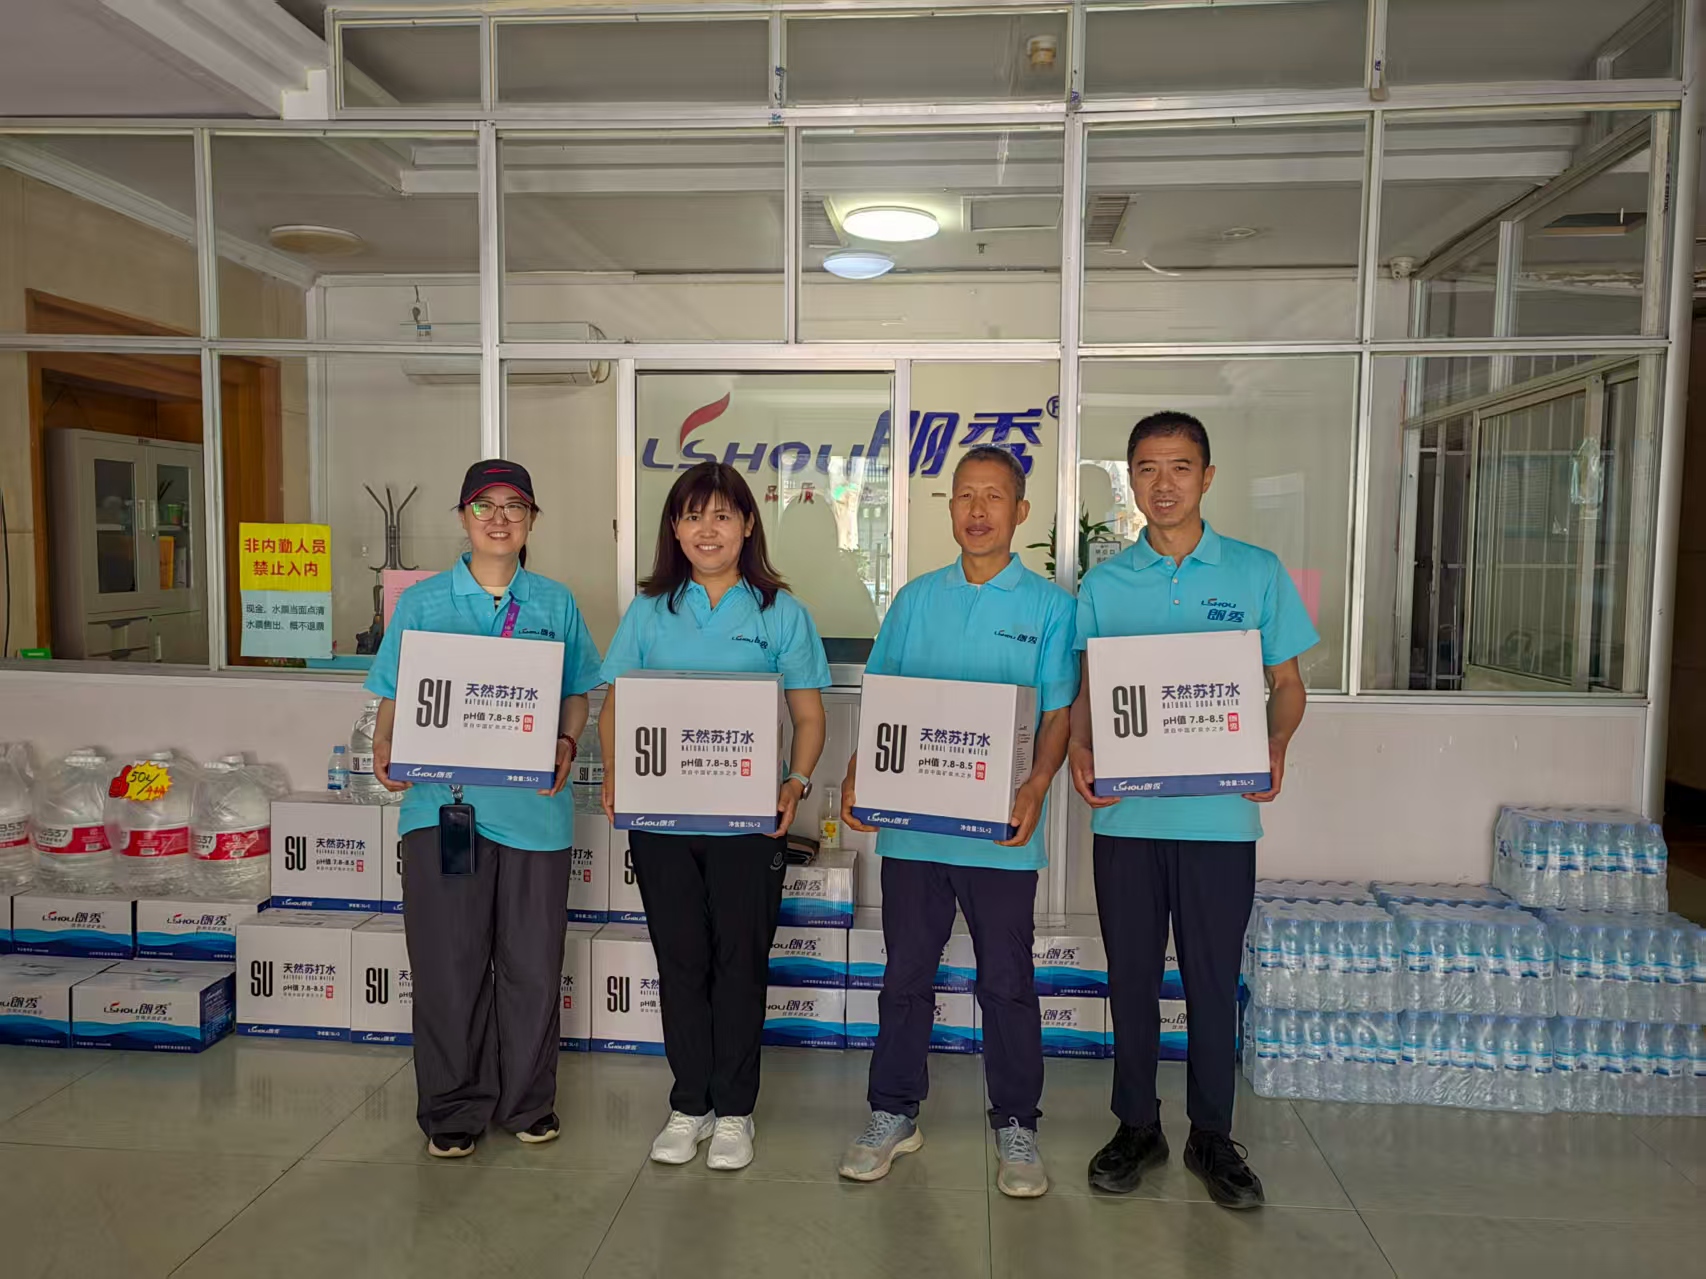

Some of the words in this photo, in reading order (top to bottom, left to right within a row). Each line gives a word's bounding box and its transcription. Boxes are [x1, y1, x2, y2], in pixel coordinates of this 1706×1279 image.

[244, 538, 327, 554] 非内勤人员
[253, 560, 319, 577] 禁止入内
[1207, 609, 1245, 623] 朗秀
[465, 683, 538, 701] 天然苏打水
[1161, 682, 1240, 700] 天然苏打水
[416, 678, 452, 728] SU
[1112, 684, 1148, 738] SU
[488, 713, 520, 723] 7.8-8.5
[1189, 714, 1224, 725] 7.8-8.5
[681, 729, 755, 744] 天然苏打水
[919, 728, 991, 748] 天然苏打水
[635, 727, 667, 777] SU
[875, 723, 907, 774] SU
[706, 759, 738, 768] 7.8-8.5
[942, 759, 973, 770] 7.8-8.5
[316, 838, 366, 850] 天然苏打水
[285, 836, 307, 871] SU
[283, 963, 336, 975] 天然苏打水
[251, 960, 273, 997] SU
[366, 967, 389, 1005] SU
[607, 976, 630, 1013] SU
